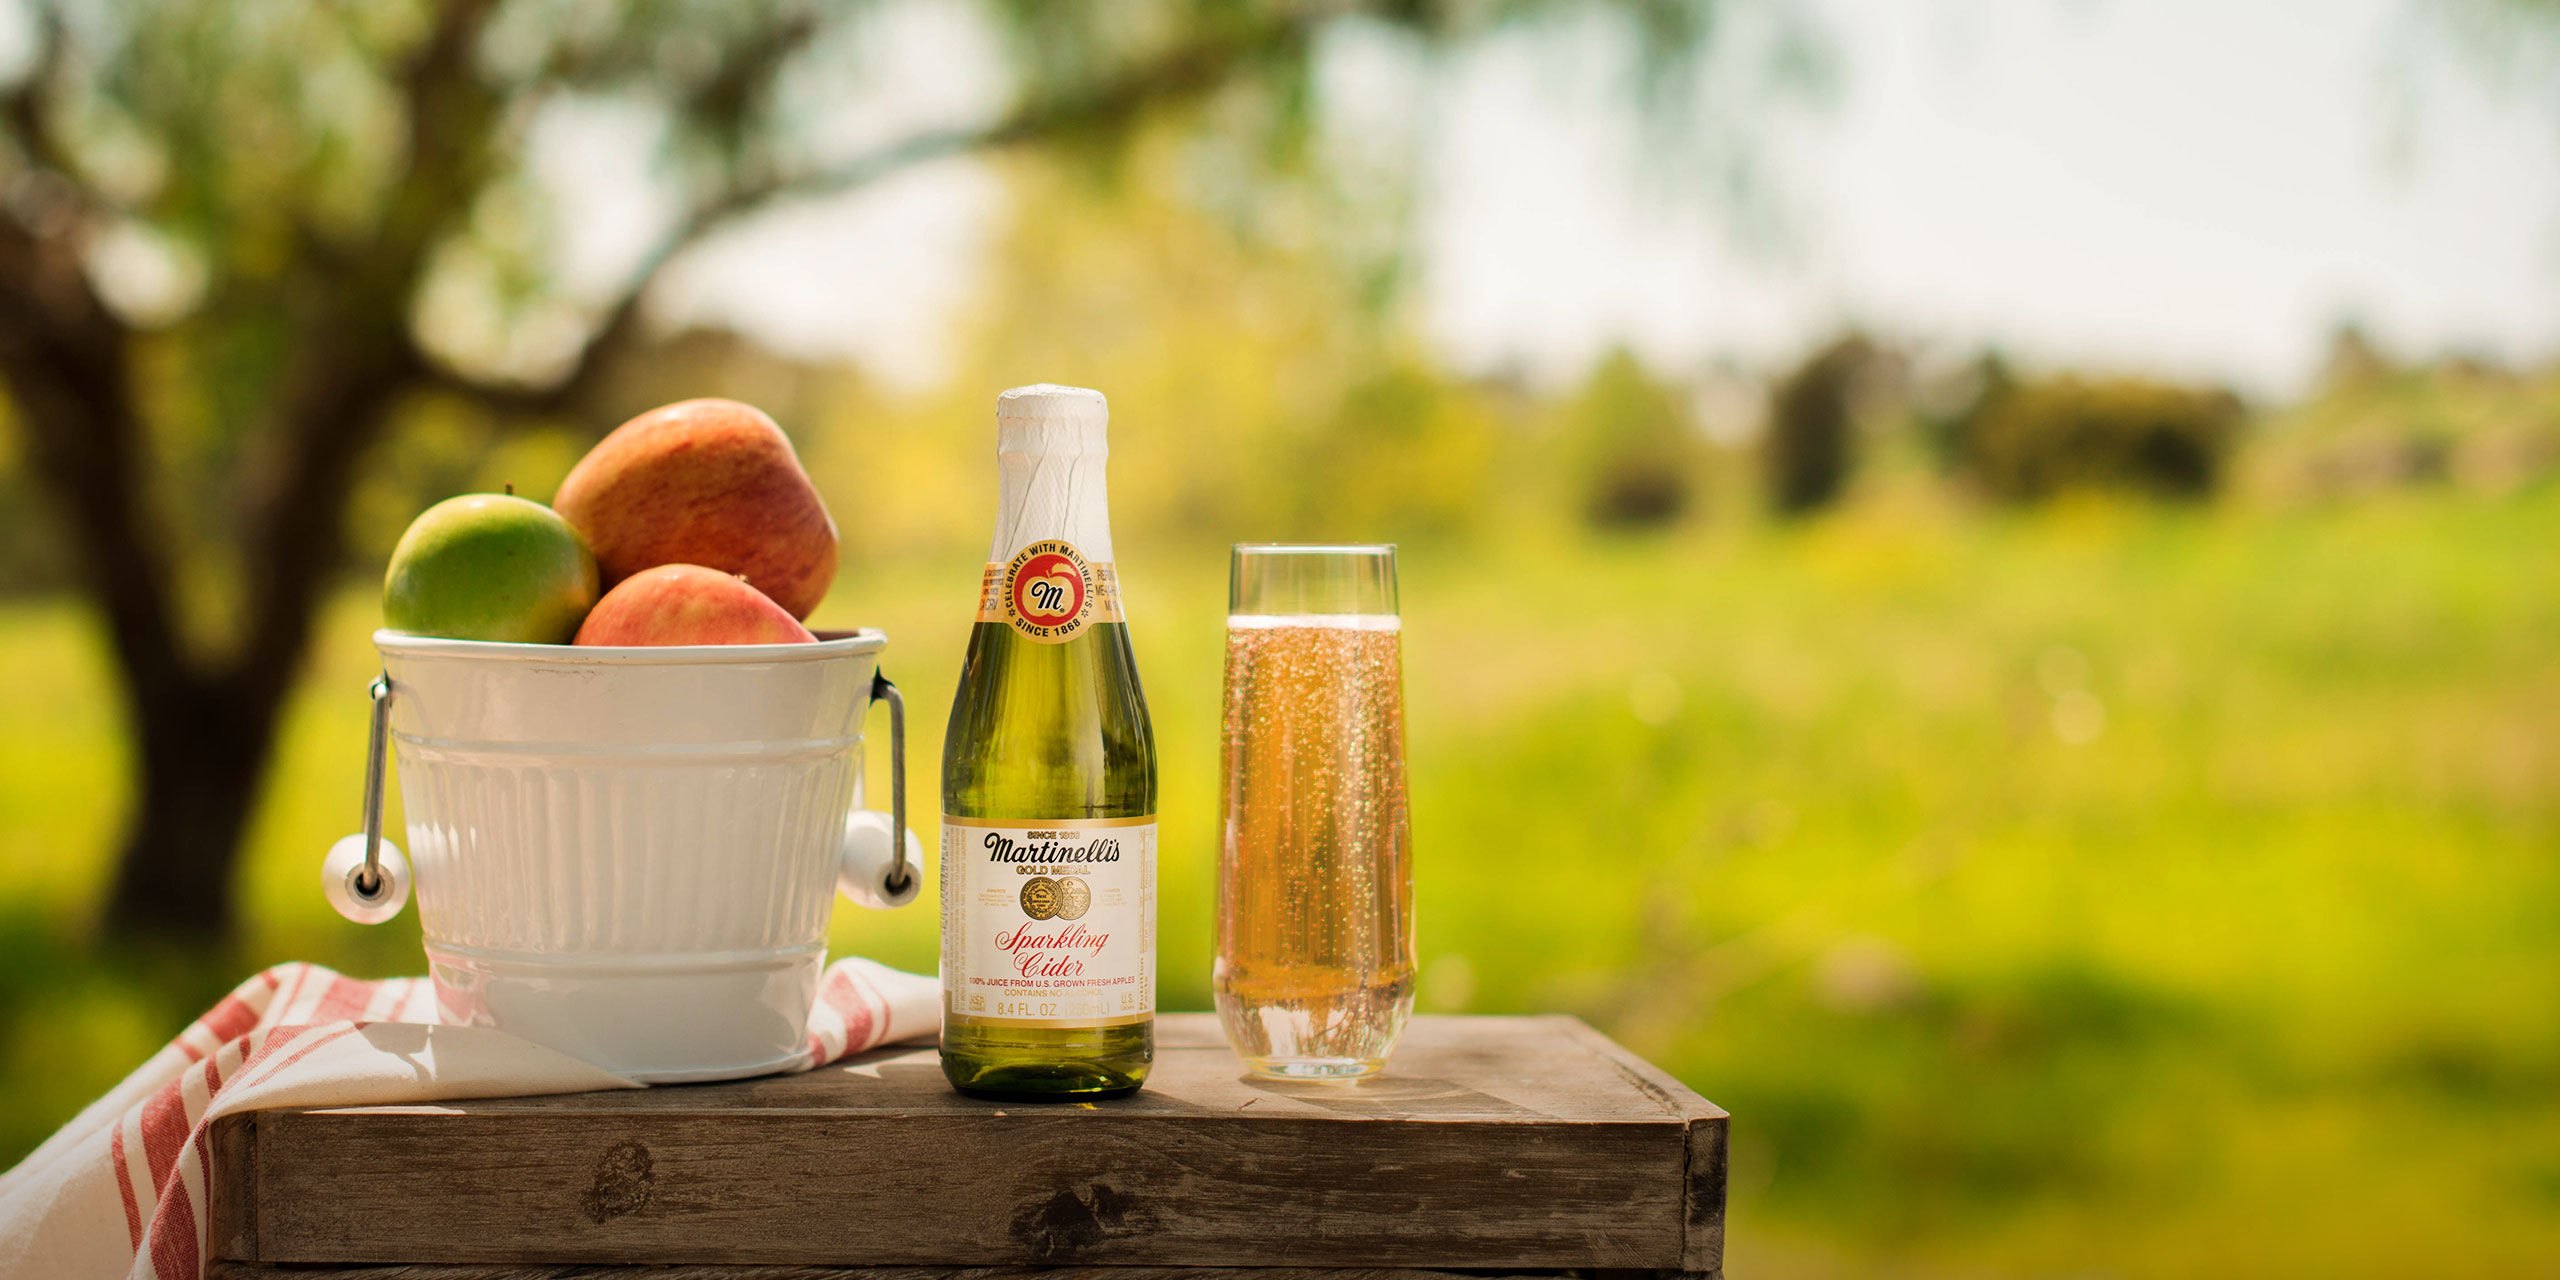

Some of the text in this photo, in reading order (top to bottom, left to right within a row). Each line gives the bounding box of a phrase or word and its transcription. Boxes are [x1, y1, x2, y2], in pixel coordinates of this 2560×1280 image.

[1005, 543, 1094, 609] CELEBRATE WITH MARTINELLI'S
[1015, 617, 1081, 637] SINCE 1868
[1027, 830, 1057, 840] SINCE
[983, 832, 1120, 863] Martinelli's
[1016, 865, 1091, 875] GOLD MEDAL
[994, 921, 1110, 958] Sparkling
[1013, 952, 1086, 978] Cider
[987, 978, 1008, 987] JUICE
[1010, 979, 1034, 988] FROM
[1035, 979, 1051, 988] U.S.
[1053, 979, 1085, 988] GROWN
[1087, 978, 1112, 987] FRESH
[1112, 976, 1135, 985] APPLES
[1004, 988, 1047, 997] CONTAINS
[1050, 989, 1062, 997] NO
[997, 1002, 1014, 1015] 8.4
[1018, 1003, 1034, 1016] FL.
